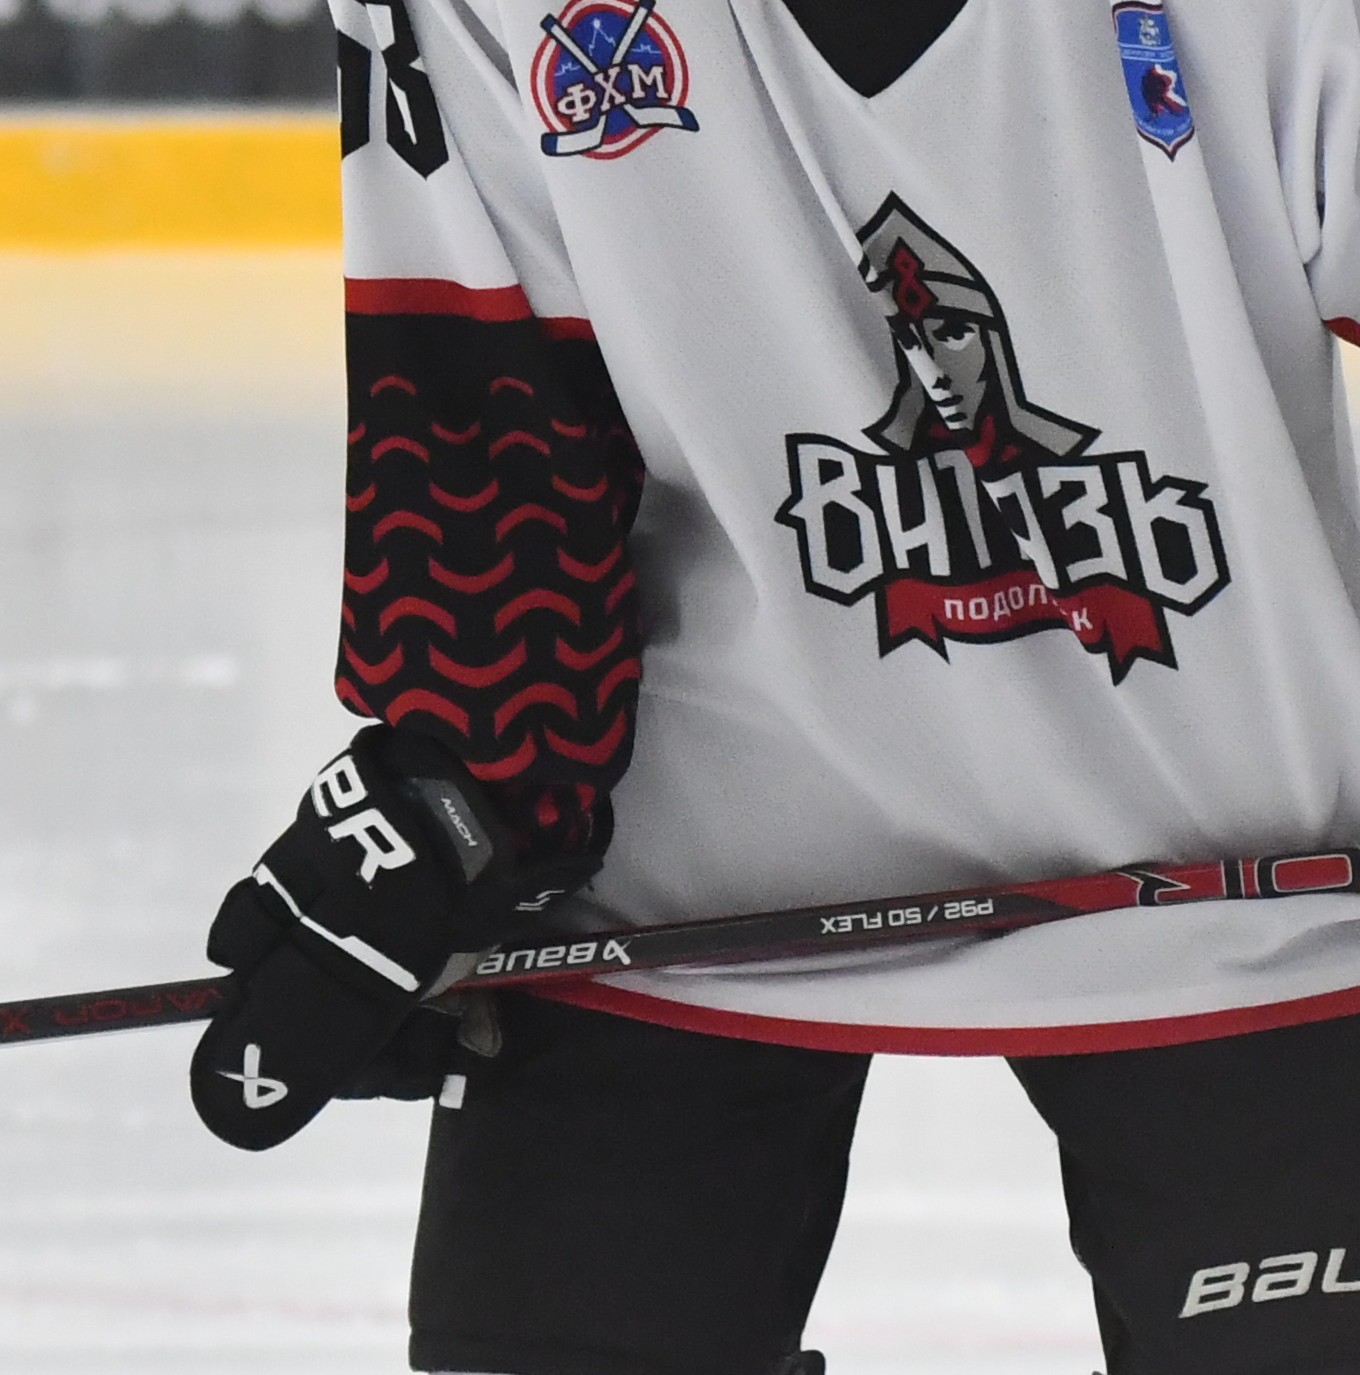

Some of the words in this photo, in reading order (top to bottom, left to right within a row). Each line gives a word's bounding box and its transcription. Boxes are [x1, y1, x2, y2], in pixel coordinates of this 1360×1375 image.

[556, 62, 670, 123] ФХМ
[943, 583, 1094, 632] ПОДОЛК
[441, 797, 478, 848] MACH
[821, 910, 882, 936] FLEX
[888, 906, 922, 927] 50
[943, 898, 995, 920] P92
[476, 939, 597, 976] BAUE
